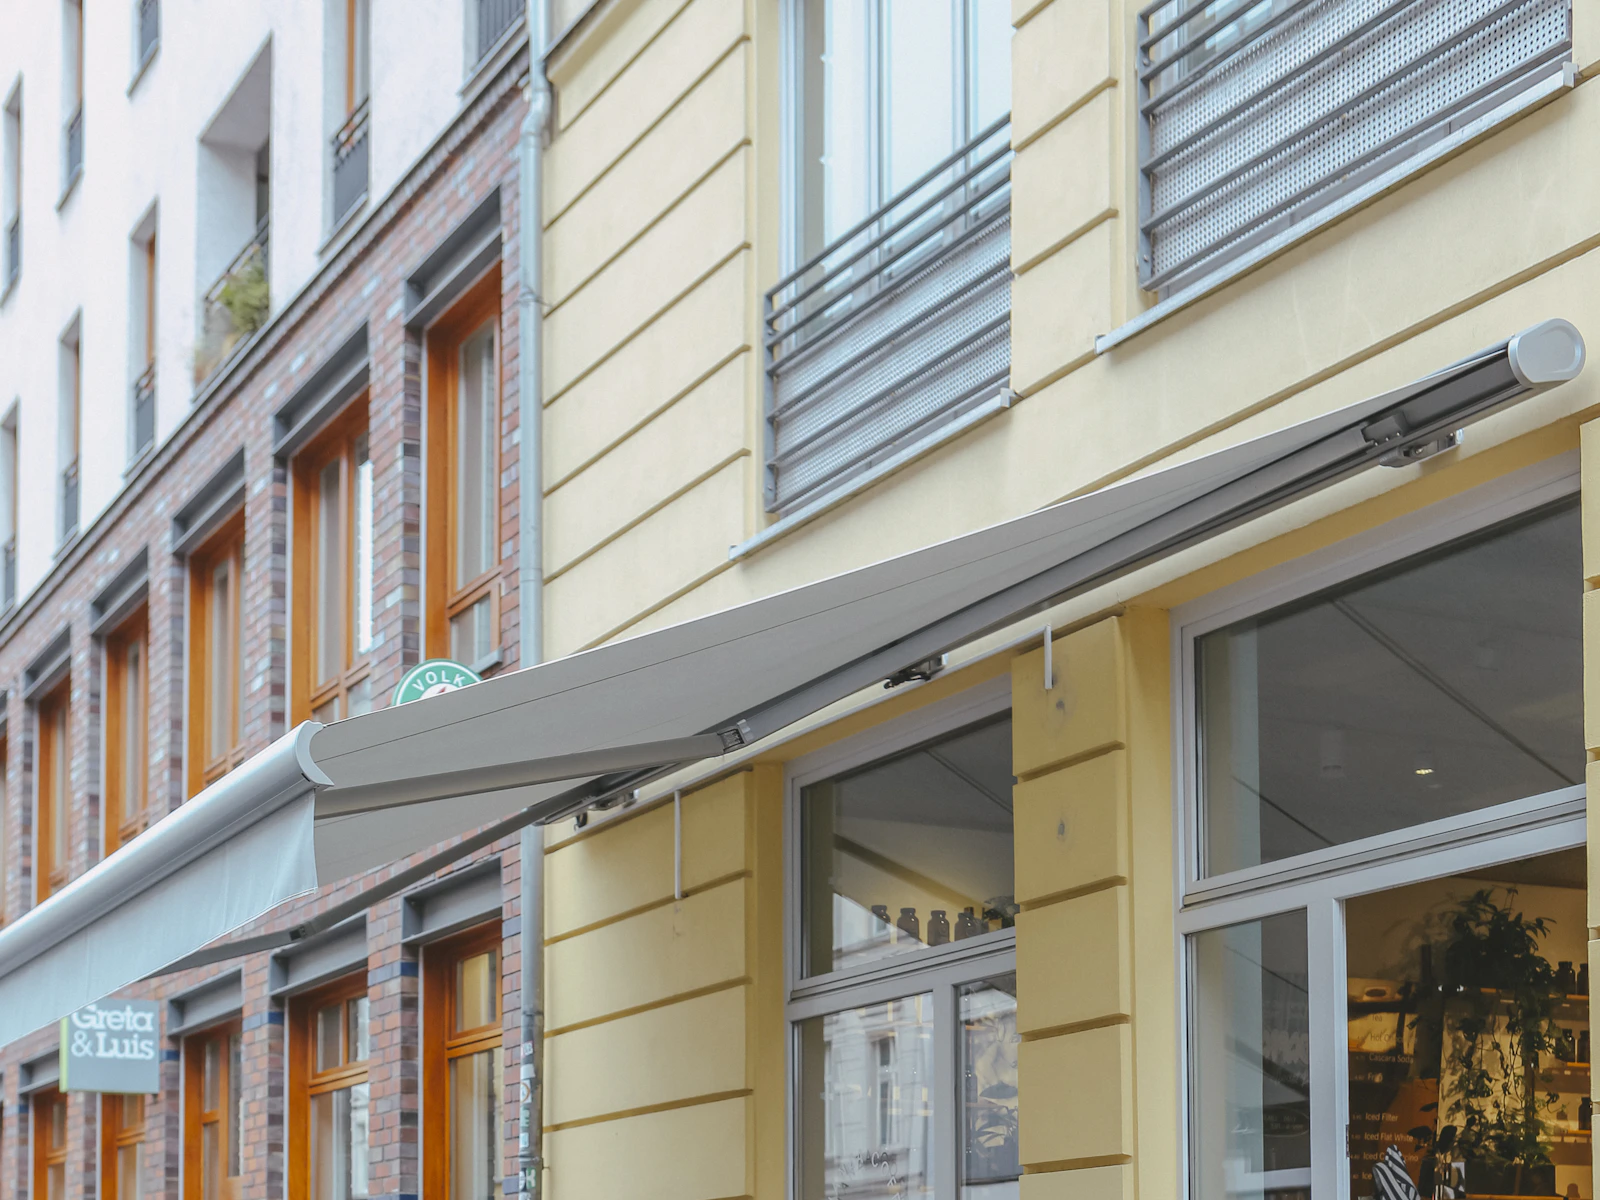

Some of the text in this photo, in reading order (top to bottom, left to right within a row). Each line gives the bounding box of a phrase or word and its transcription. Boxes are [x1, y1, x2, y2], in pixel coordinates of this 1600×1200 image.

[412, 670, 466, 691] VOLK
[71, 1004, 154, 1032] Greta
[71, 1030, 155, 1061] & Luis
[1369, 1053, 1396, 1063] Cascara
[1397, 1054, 1414, 1064] Soda
[1365, 1112, 1380, 1121] Iced
[1382, 1112, 1399, 1122] Filter
[1364, 1132, 1379, 1141] Iced
[1380, 1132, 1392, 1141] Flat
[1394, 1133, 1414, 1142] White
[1363, 1152, 1378, 1160] Iced
